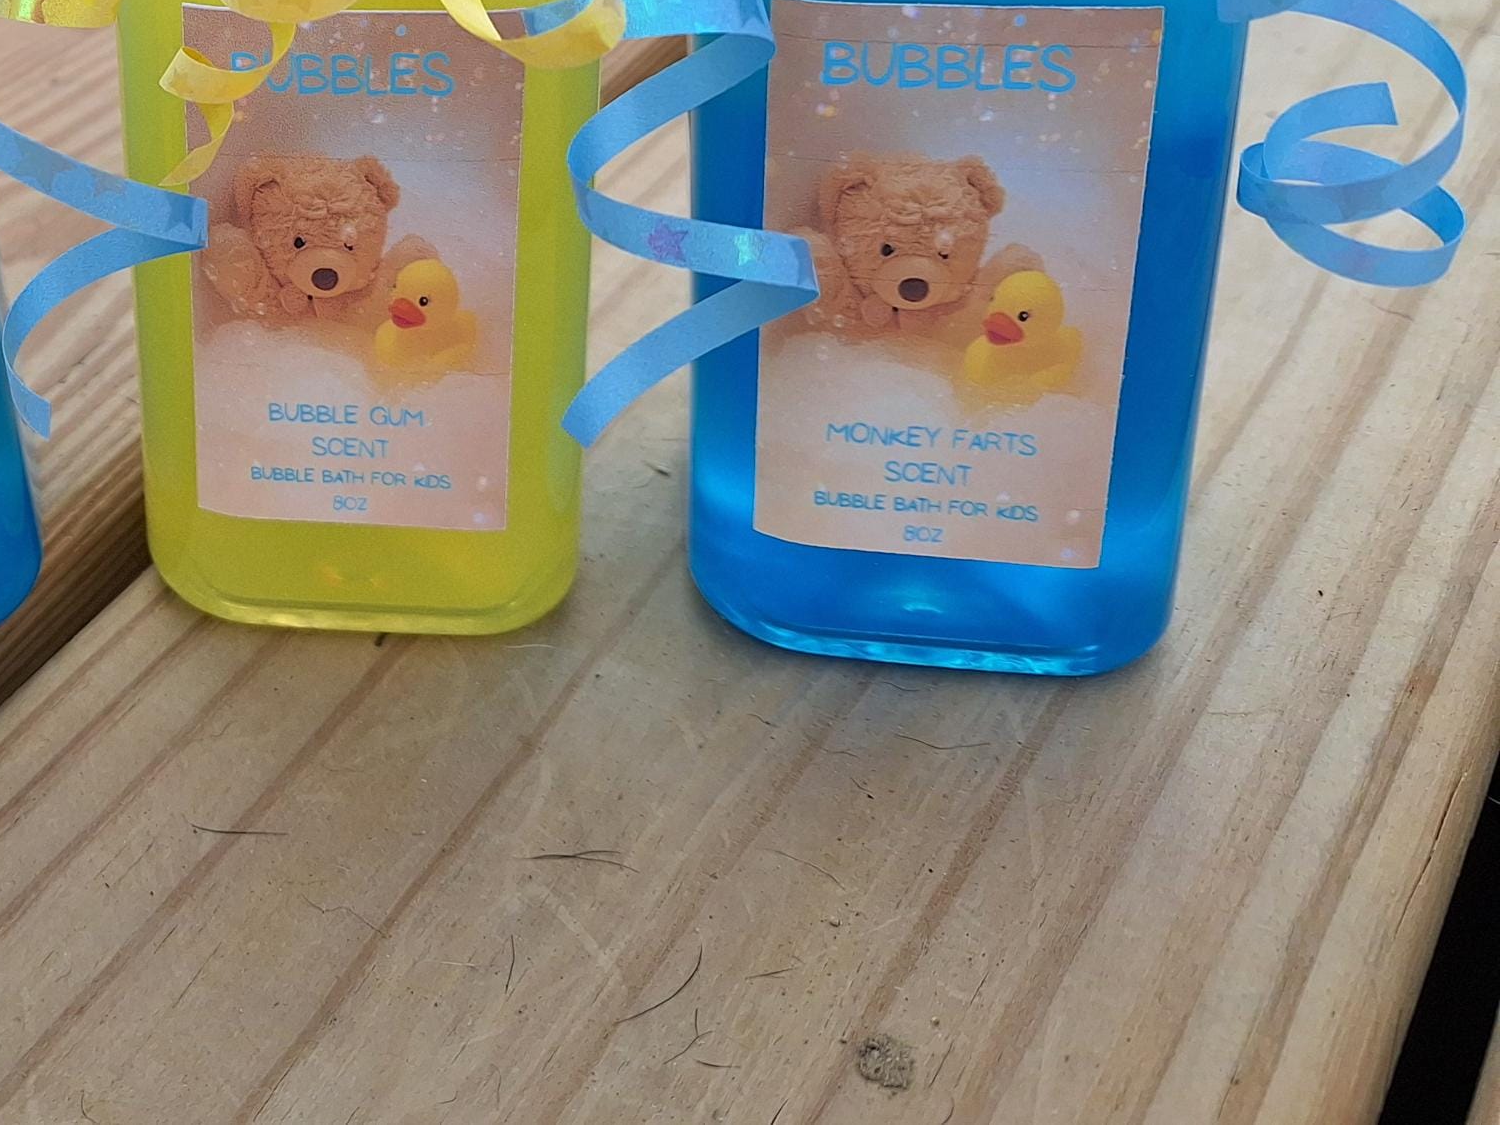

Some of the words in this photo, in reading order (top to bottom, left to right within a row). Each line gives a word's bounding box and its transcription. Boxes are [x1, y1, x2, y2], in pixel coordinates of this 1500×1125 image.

[820, 41, 1076, 93] BUBBLES
[268, 402, 359, 424] BUBBLE
[370, 406, 424, 426] GUM
[311, 436, 389, 458] SCENT
[826, 422, 942, 448] MONKEY
[952, 429, 1038, 456] FARTS
[250, 466, 314, 483] BUBBLE
[322, 469, 364, 484] BATH
[371, 471, 406, 486] FOR
[884, 460, 973, 486] SCENT
[813, 490, 887, 511] BUBBLE
[893, 496, 942, 513] BATH
[948, 500, 988, 517] FOR
